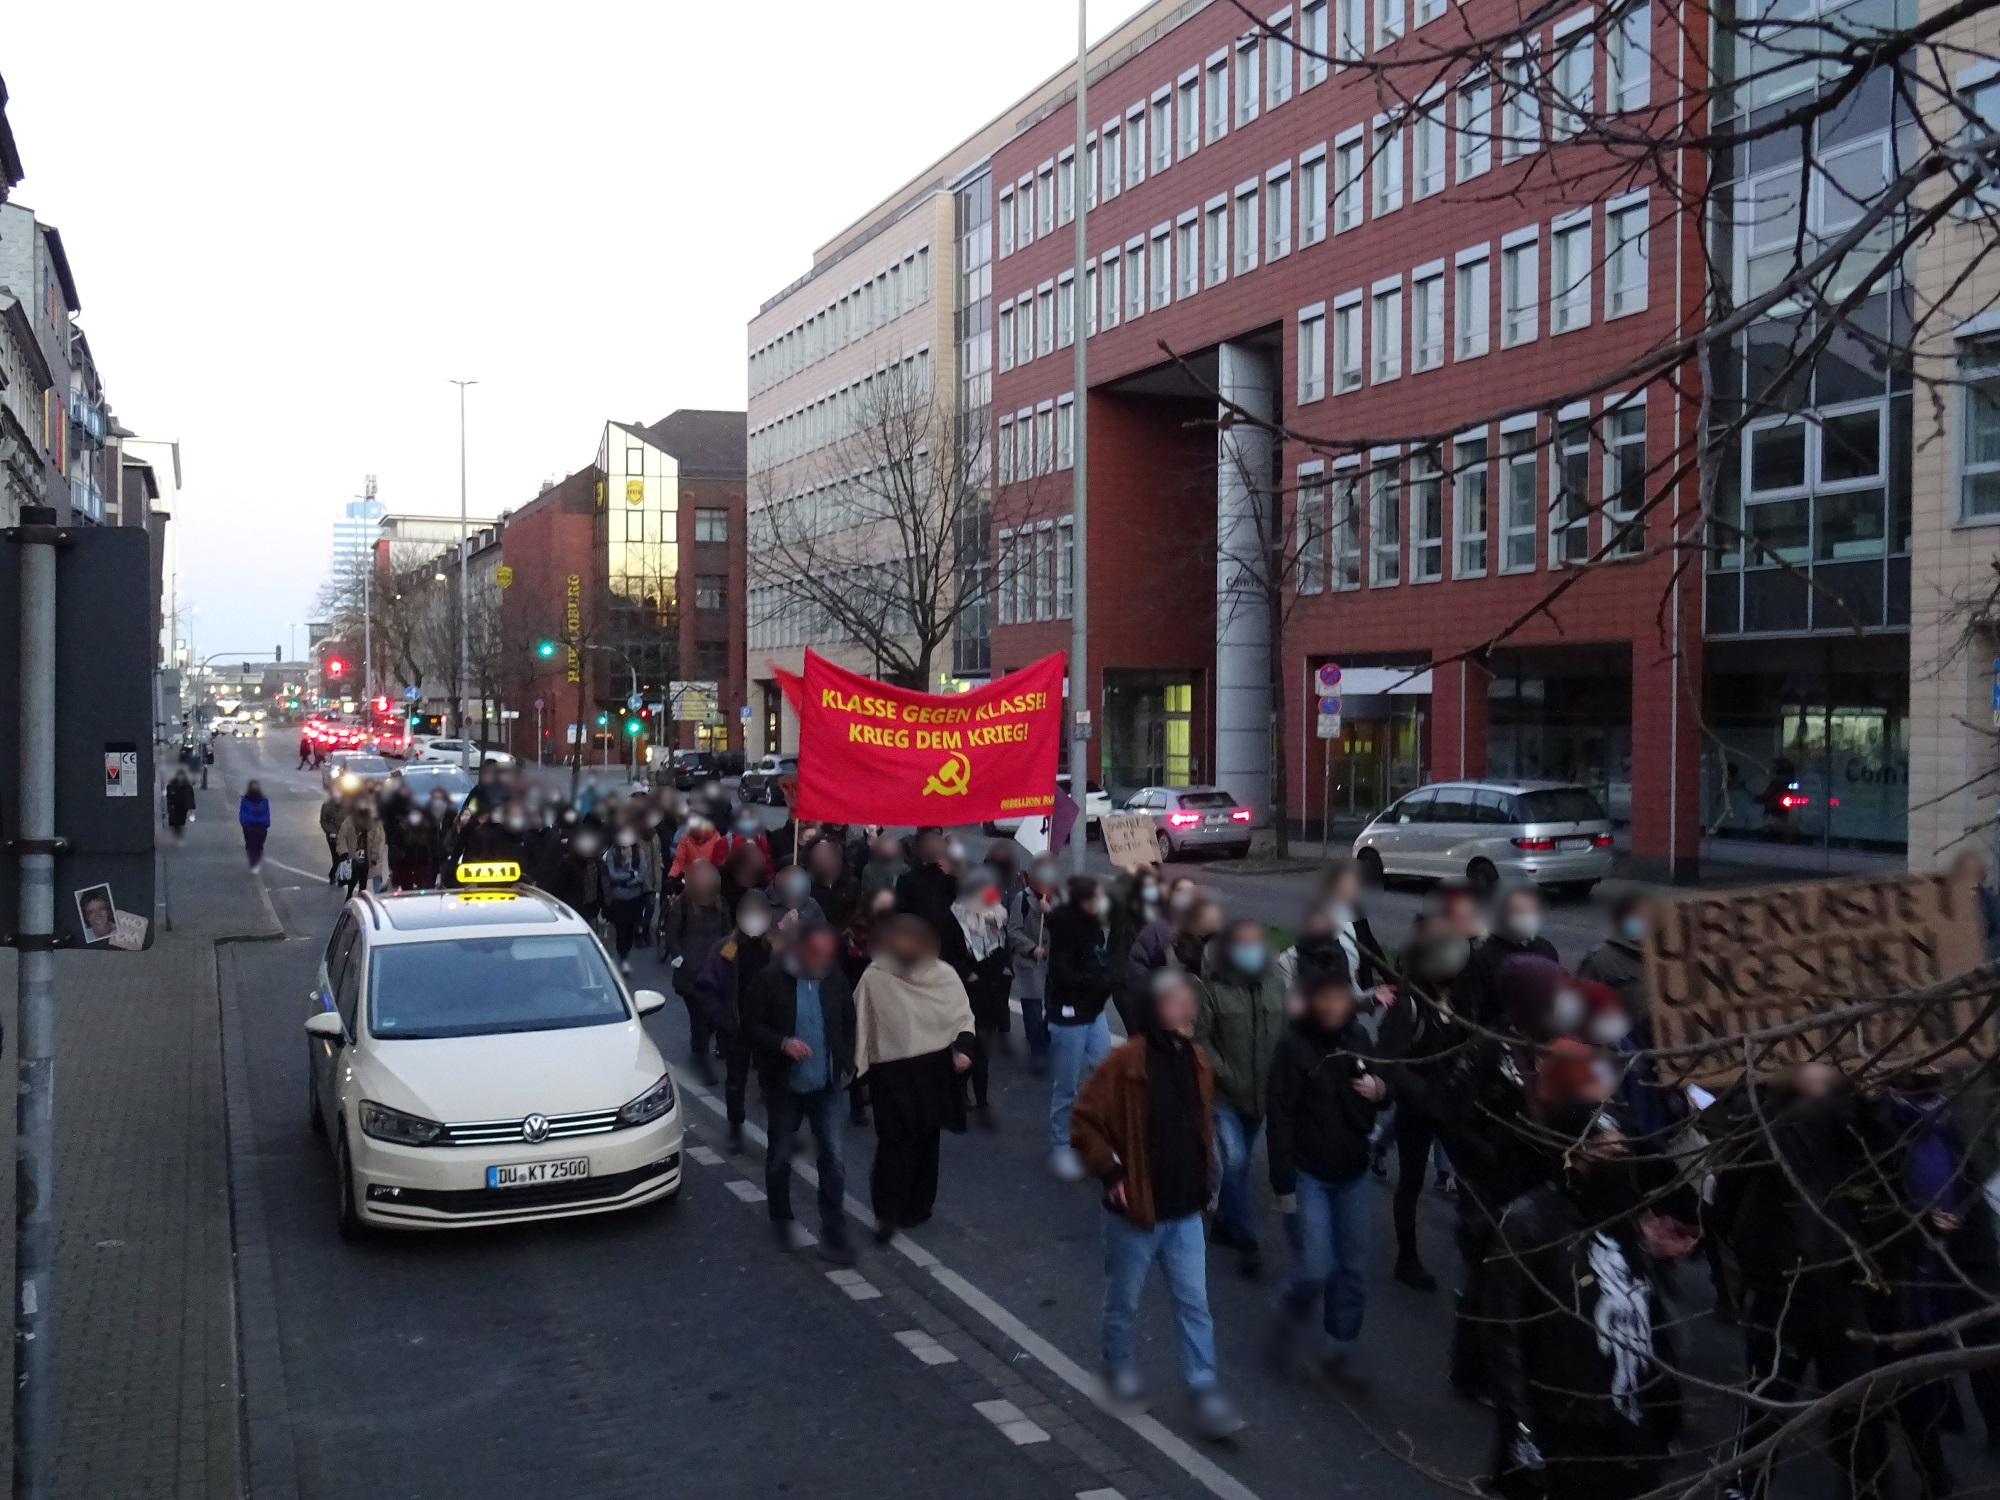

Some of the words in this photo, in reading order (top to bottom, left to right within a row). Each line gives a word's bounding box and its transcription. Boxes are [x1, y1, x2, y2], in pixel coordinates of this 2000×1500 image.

[822, 688, 898, 720] KLASSE
[902, 704, 971, 724] GEGEN
[975, 691, 1047, 722] KLASSE!
[849, 722, 910, 749] KRIEG
[916, 729, 963, 750] DEM
[967, 722, 1029, 747] KRIEG!
[1000, 796, 1041, 811] REBELLION
[464, 866, 516, 878] TAXI
[499, 1168, 517, 1184] DU
[528, 1164, 547, 1181] KT
[551, 1160, 586, 1178] 2500
